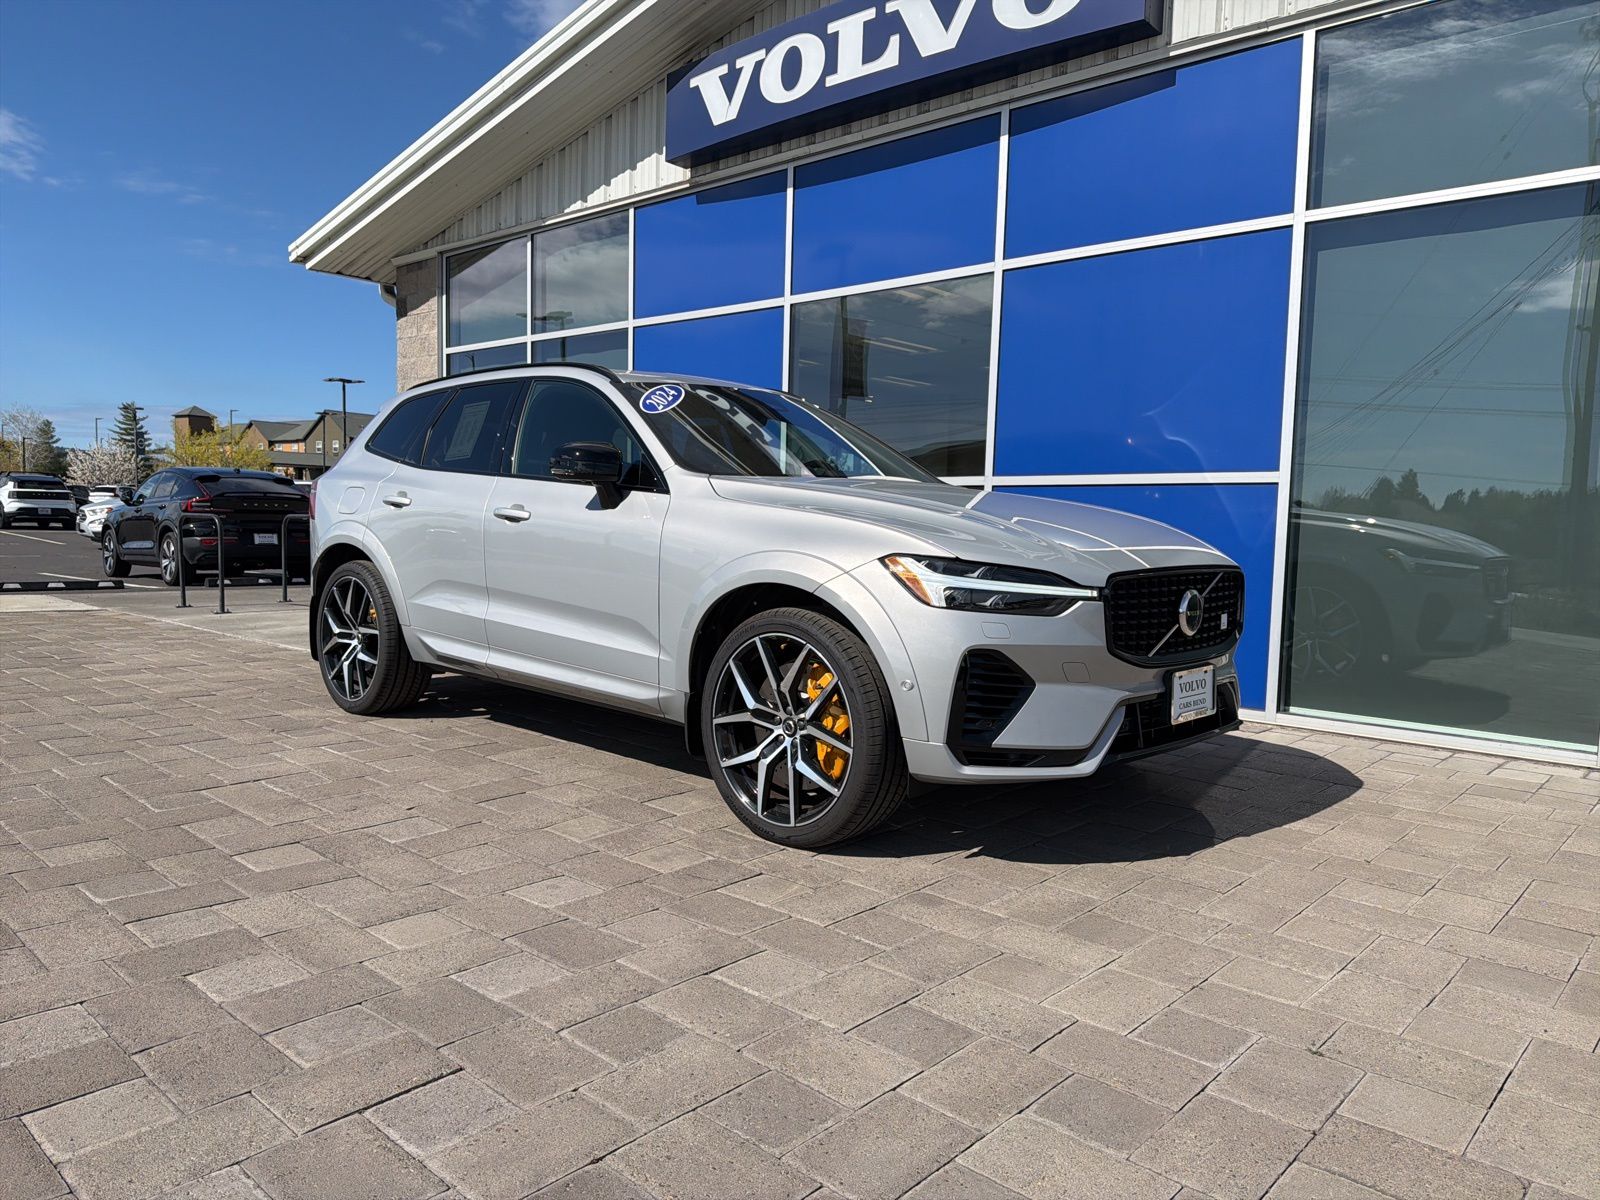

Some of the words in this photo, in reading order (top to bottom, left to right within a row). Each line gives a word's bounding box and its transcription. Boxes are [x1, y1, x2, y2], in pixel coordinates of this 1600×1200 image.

[645, 385, 678, 411] 2024
[1179, 678, 1207, 694] VOLVO
[1179, 700, 1193, 710] CARS
[1193, 698, 1207, 707] BEND
